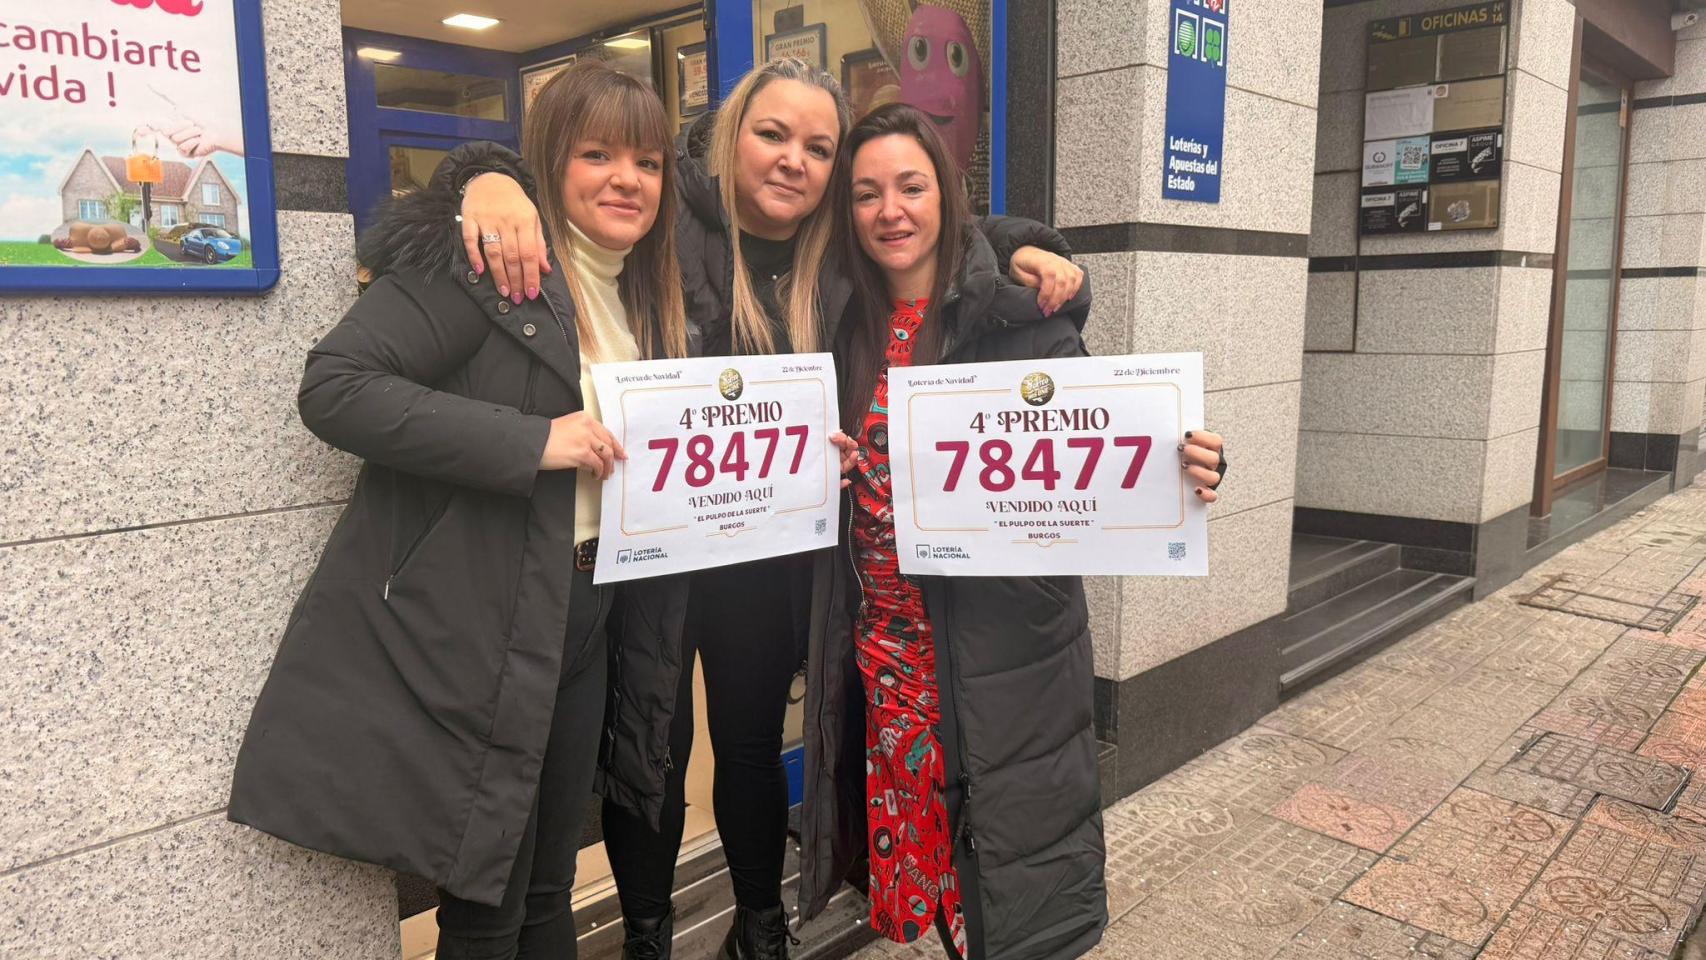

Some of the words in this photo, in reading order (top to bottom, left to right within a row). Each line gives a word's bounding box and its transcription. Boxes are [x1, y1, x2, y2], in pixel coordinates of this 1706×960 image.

[1421, 8, 1488, 31] OFICINAS
[1492, 13, 1503, 24] 14
[775, 41, 792, 51] GRAN
[793, 36, 815, 48] PREMIO
[0, 63, 86, 104] vida
[1170, 135, 1202, 155] Loterías
[1202, 144, 1208, 159] y
[1169, 155, 1205, 174] Apuestas
[1205, 160, 1218, 176] del
[1168, 174, 1195, 191] Estado
[1135, 367, 1180, 376] Diciembre
[679, 408, 697, 429] 4º
[701, 401, 782, 428] PREMIO
[969, 411, 991, 433] 4º
[997, 407, 1110, 433] PREMIO
[648, 425, 809, 492] 78477
[935, 435, 1152, 492] 78477
[688, 491, 742, 508] VENDIDO
[745, 484, 773, 501] AQUÍ
[986, 500, 1053, 513] VENDIDO
[1057, 496, 1097, 514] AQUÍ
[705, 512, 727, 521] PULPO
[745, 506, 767, 515] SUERTE
[719, 521, 745, 531] BURGOS
[633, 552, 668, 562] NACIONAL
[634, 547, 662, 556] LOTERÍA
